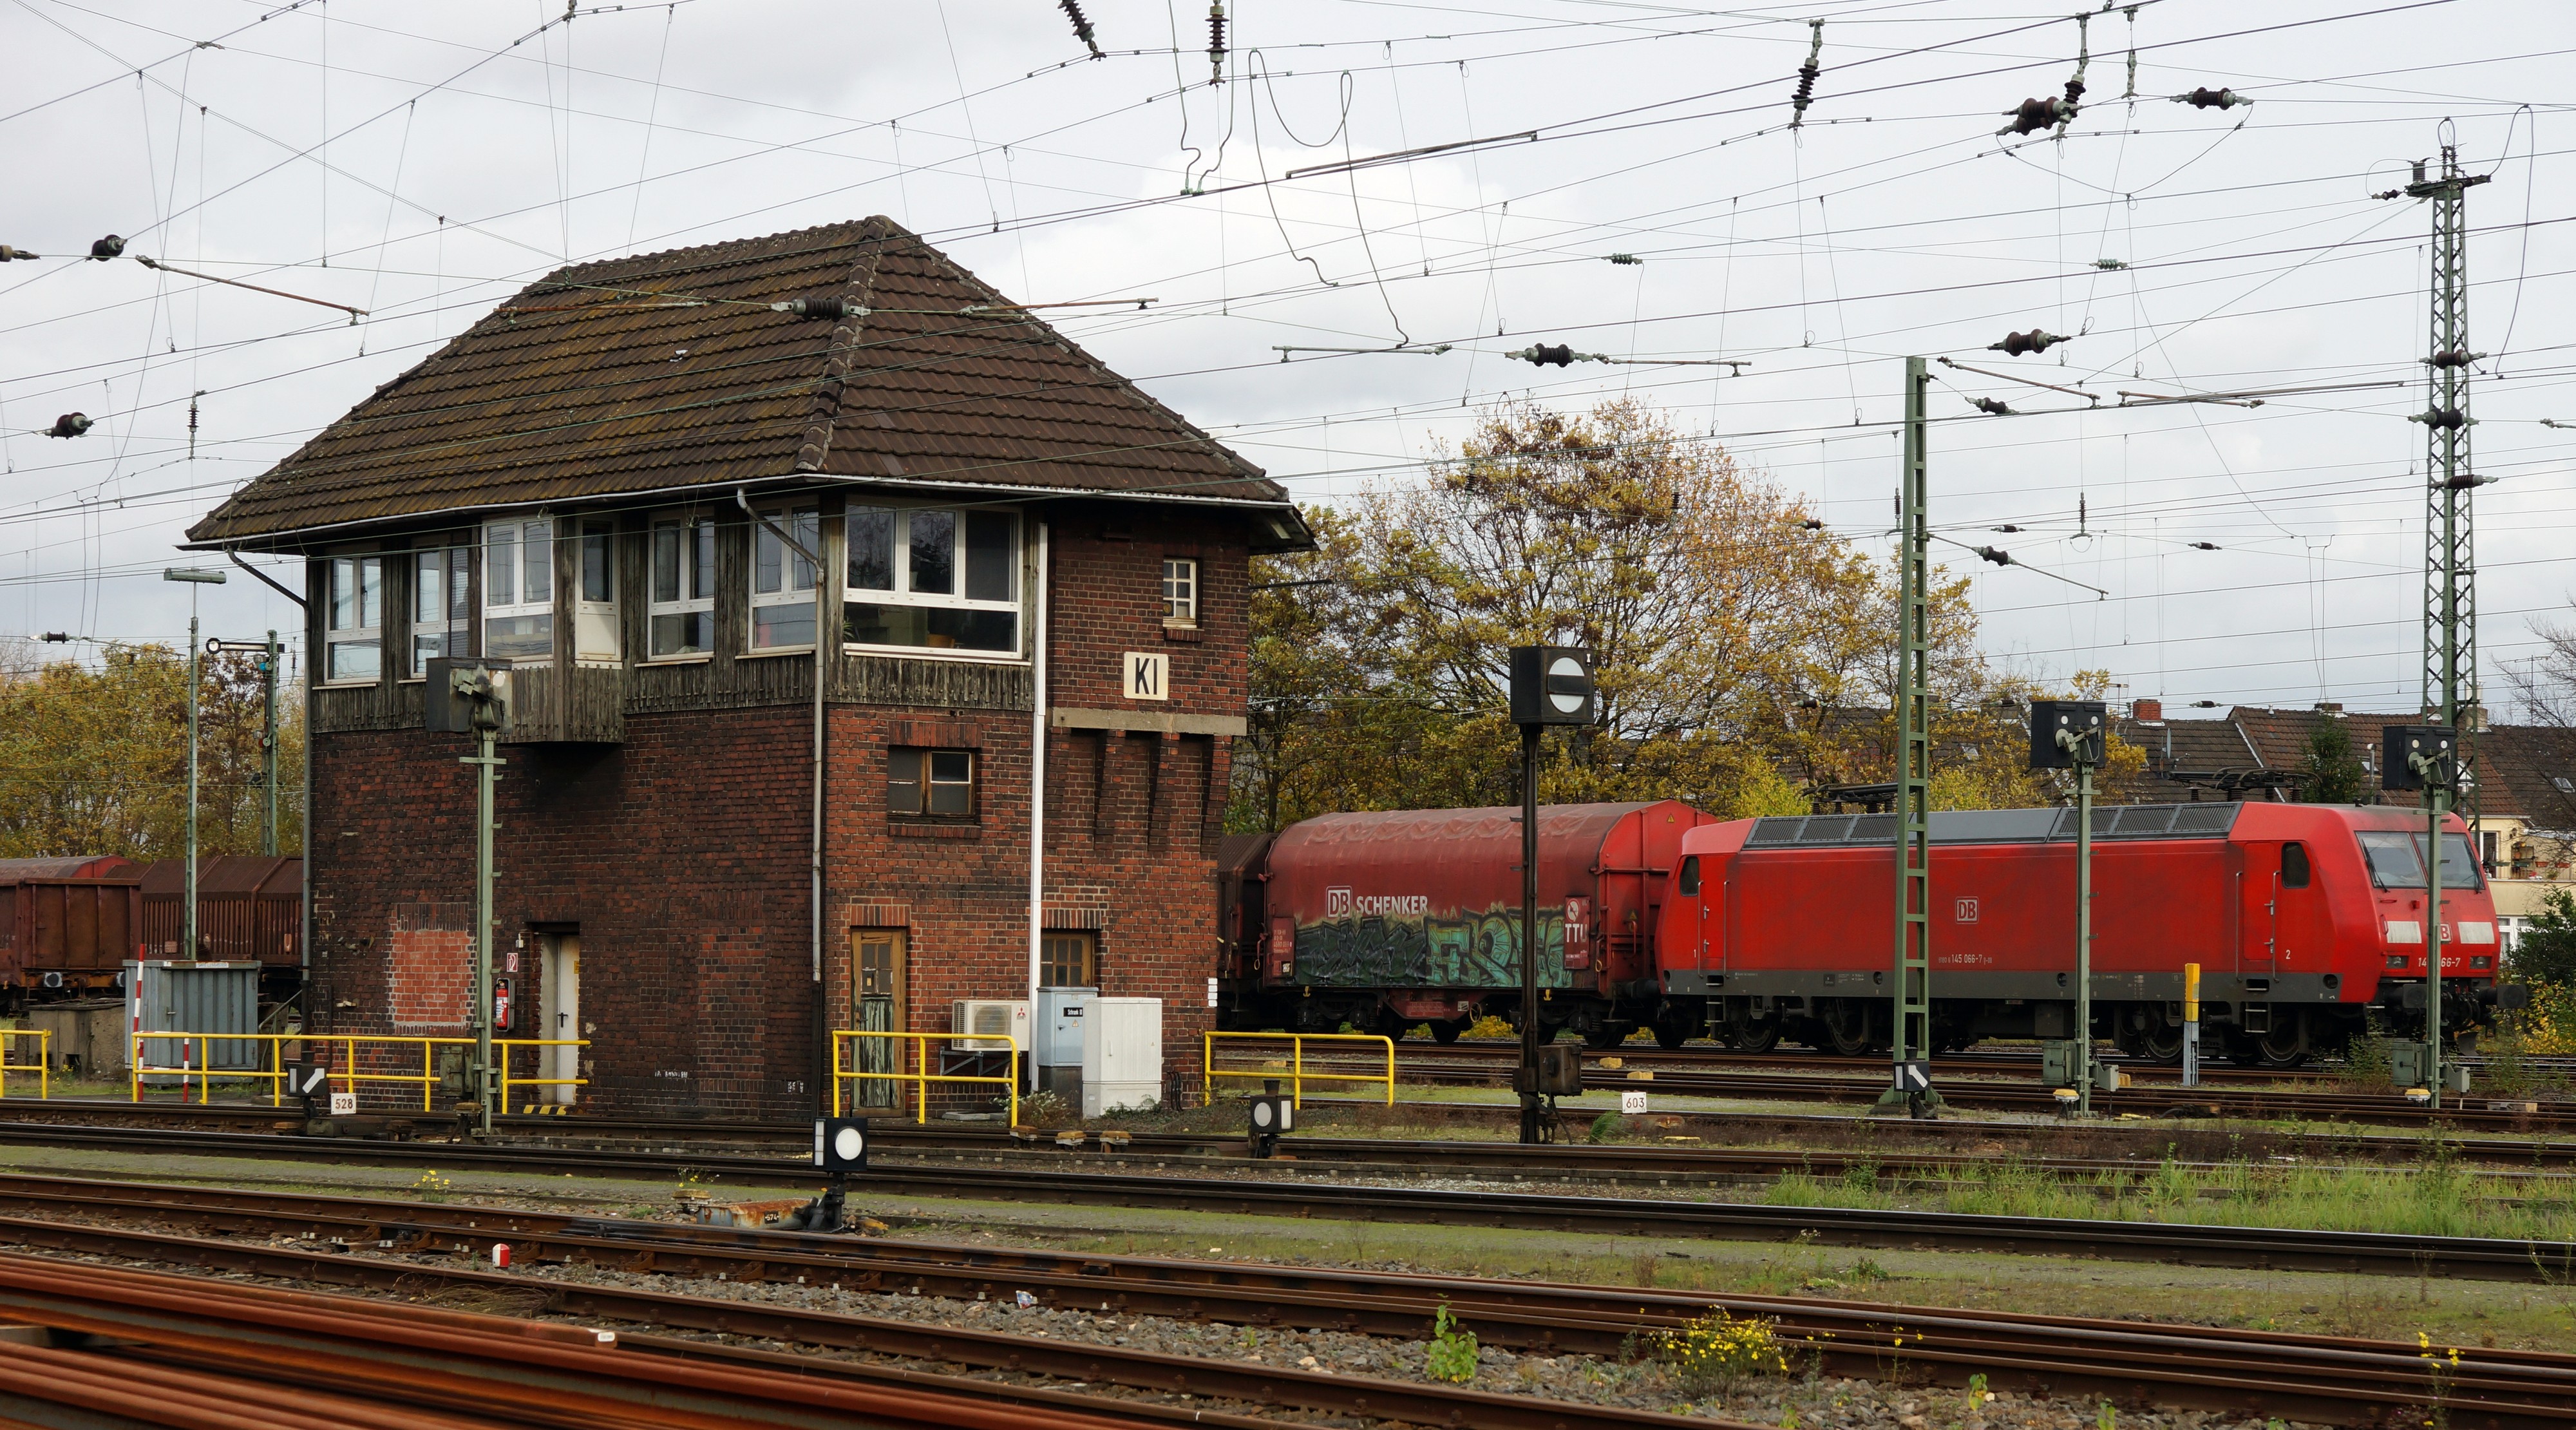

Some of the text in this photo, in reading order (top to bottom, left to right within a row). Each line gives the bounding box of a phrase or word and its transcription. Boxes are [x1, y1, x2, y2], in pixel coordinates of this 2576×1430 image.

[1328, 890, 1428, 917] DB SCHENKER
[1957, 899, 1978, 921] DB
[1565, 923, 1587, 942] TTU
[1694, 949, 1696, 958] 1
[1951, 954, 1962, 964] 145
[1964, 954, 1982, 964] 066-7
[2286, 949, 2291, 960] 2
[2441, 957, 2461, 967] 66-7
[335, 1098, 354, 1109] 528
[1626, 1097, 1645, 1109] 603
